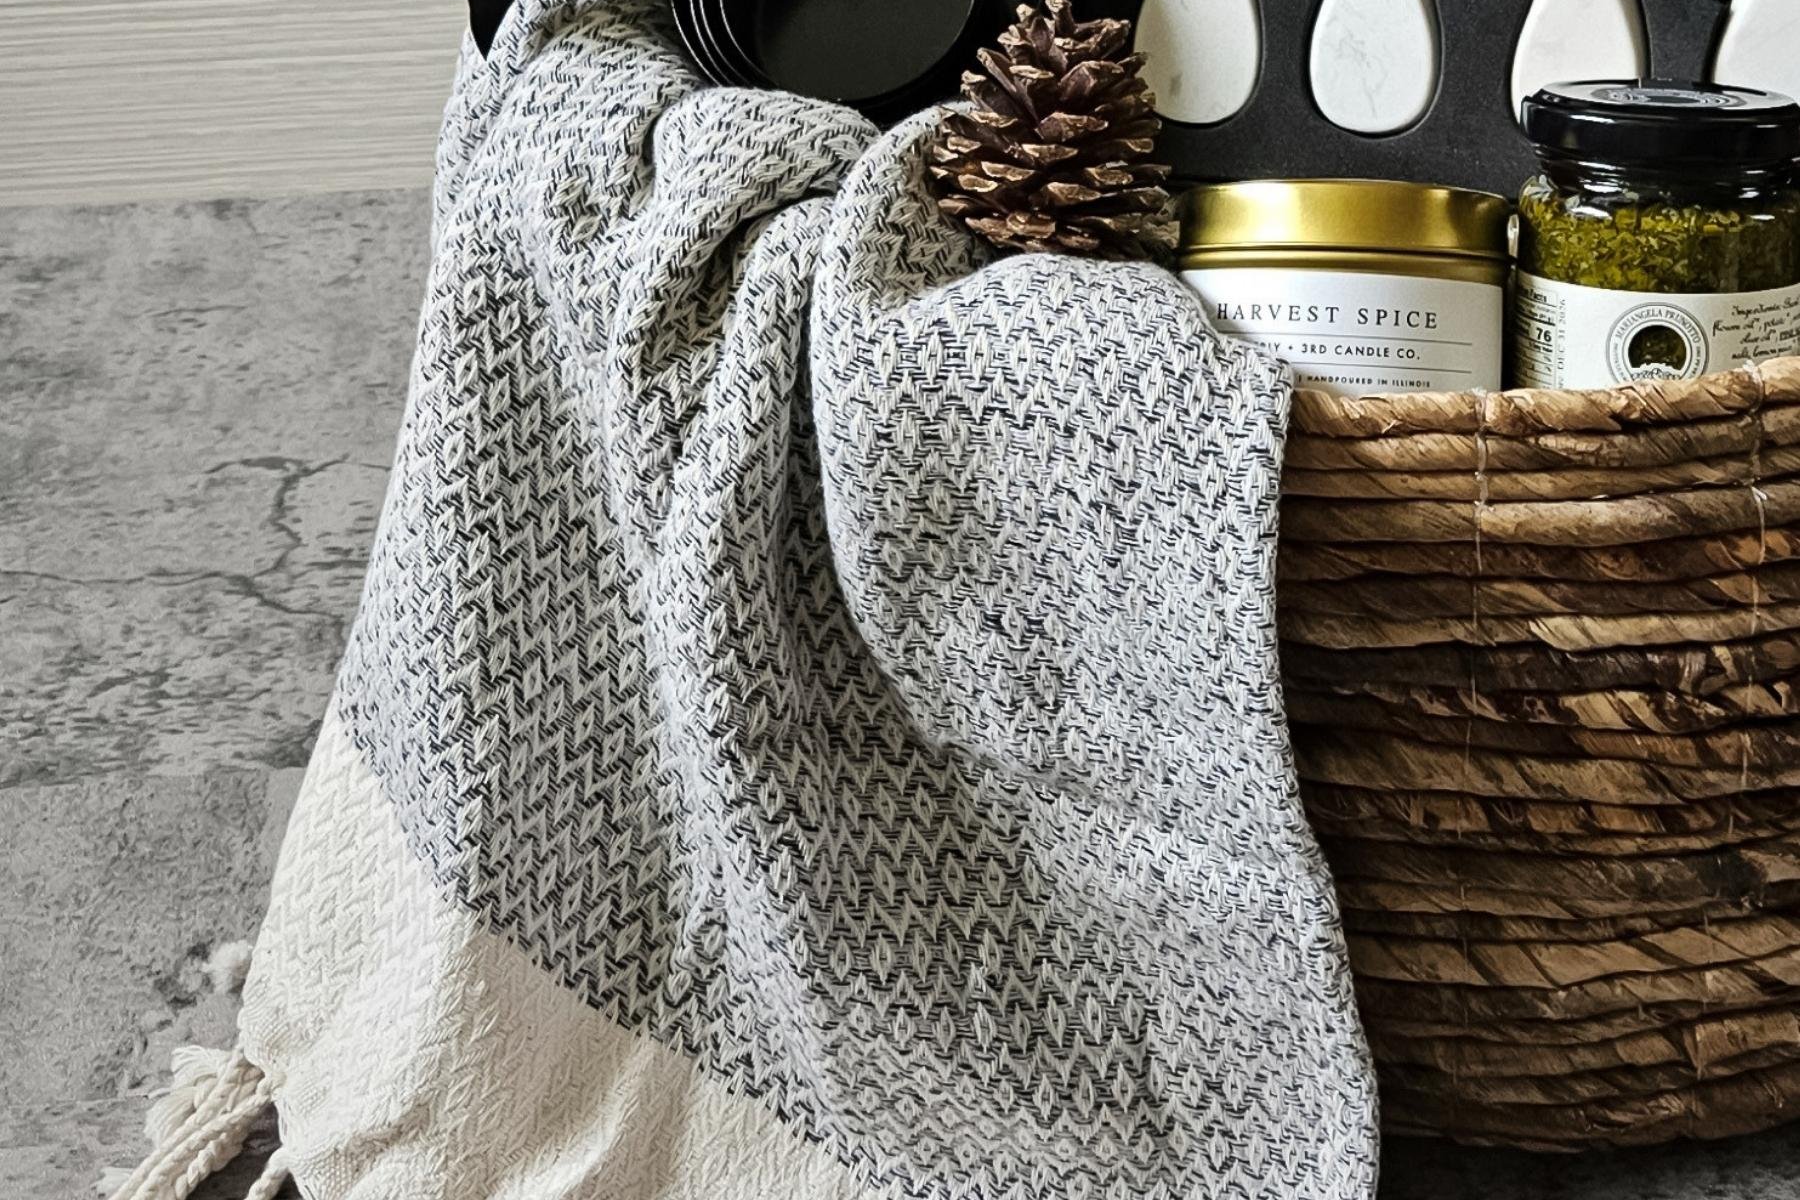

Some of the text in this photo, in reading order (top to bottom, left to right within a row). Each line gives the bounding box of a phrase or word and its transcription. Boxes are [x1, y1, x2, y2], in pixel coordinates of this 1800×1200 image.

[1216, 302, 1439, 329] HARVEST SPICE
[1536, 327, 1552, 343] 76
[1614, 308, 1663, 339] MARIANGELA
[1665, 309, 1702, 344] PRUNOTTO
[1301, 343, 1421, 361] 3RD CANDLE CO.
[1307, 375, 1432, 389] HANDPOURED IN ILLINOIS
